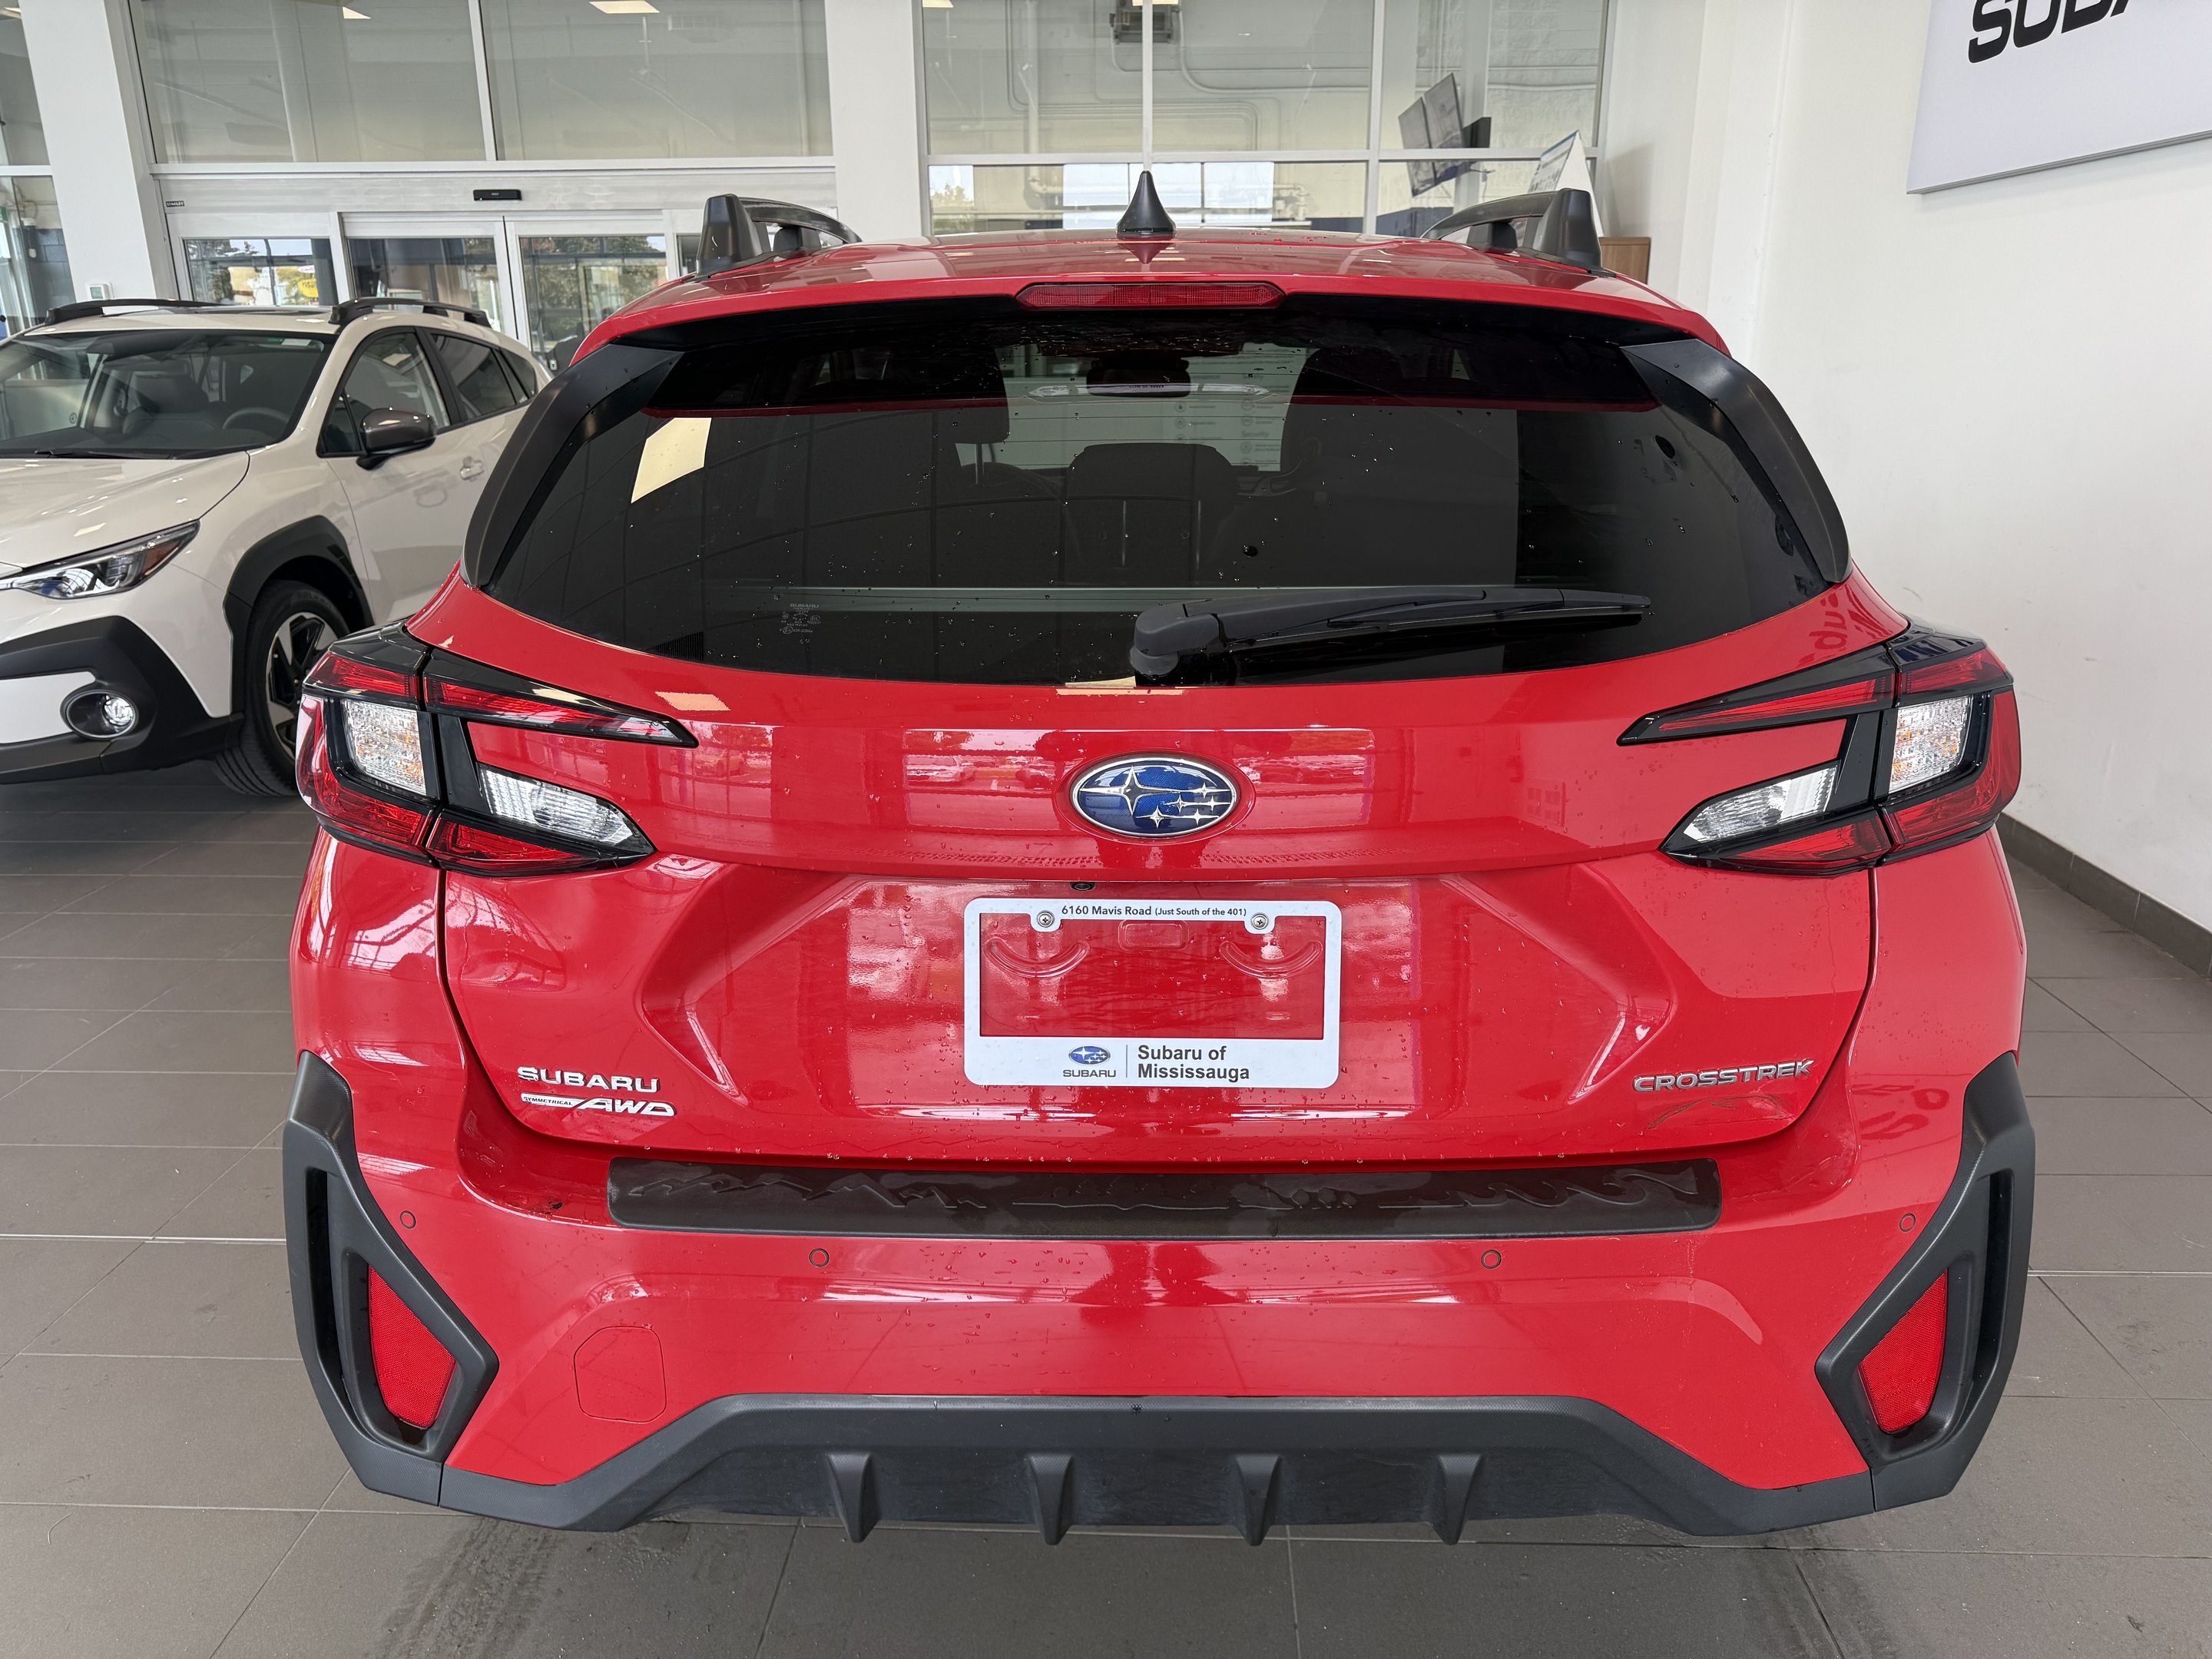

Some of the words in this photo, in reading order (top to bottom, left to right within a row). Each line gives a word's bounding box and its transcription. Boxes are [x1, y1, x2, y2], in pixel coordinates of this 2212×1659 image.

[1968, 0, 2130, 64] SU
[1061, 905, 1089, 915] 6160
[1091, 906, 1122, 915] Mavis
[1124, 906, 1152, 916] Road
[1154, 907, 1174, 916] (Just
[1176, 907, 1200, 916] South
[1201, 907, 1211, 916] of
[1227, 908, 1247, 916] 401)
[1137, 1045, 1202, 1060] Subaru
[1207, 1045, 1227, 1061] of
[517, 1066, 661, 1094] SUBARU
[1062, 1069, 1117, 1078] SUBARU
[1137, 1063, 1250, 1083] Mississauga
[1633, 1058, 1814, 1092] CROSSTREK
[522, 1095, 574, 1107] SYMMETRICAL
[577, 1097, 677, 1118] AWD
